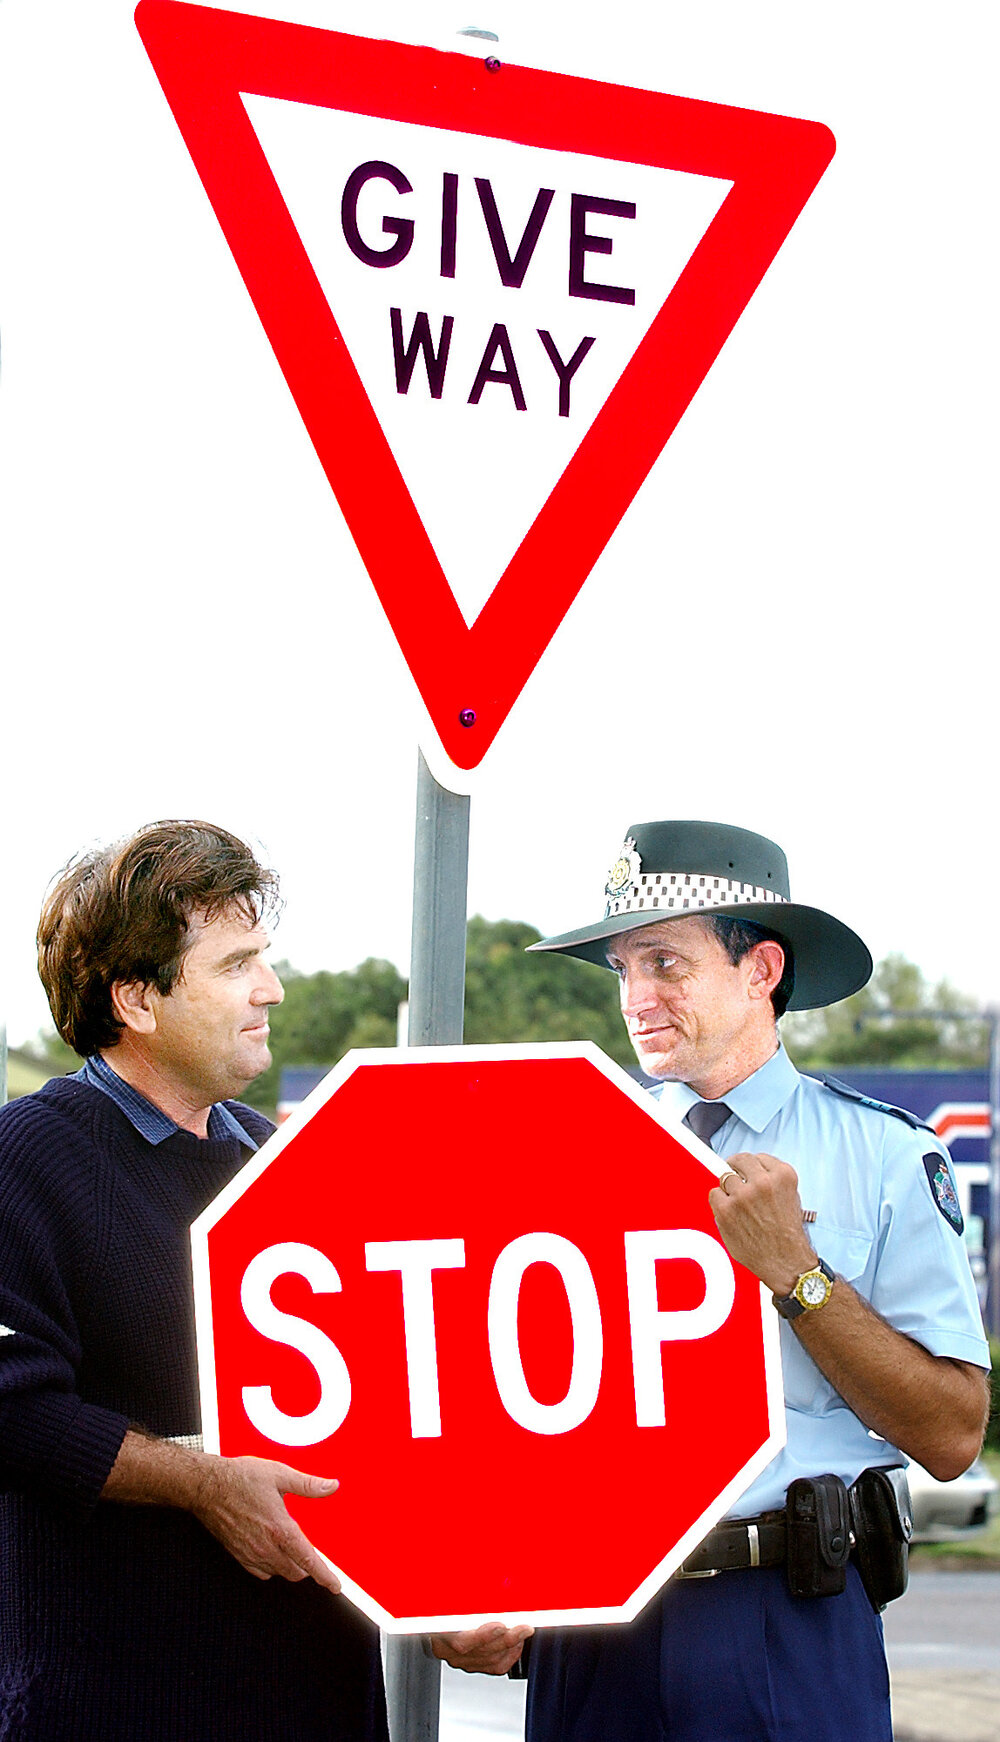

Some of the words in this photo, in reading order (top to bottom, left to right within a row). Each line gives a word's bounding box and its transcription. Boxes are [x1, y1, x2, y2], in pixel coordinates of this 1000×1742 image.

[341, 160, 637, 305] GIVE
[390, 307, 597, 417] WAY
[240, 1228, 736, 1447] STOP
